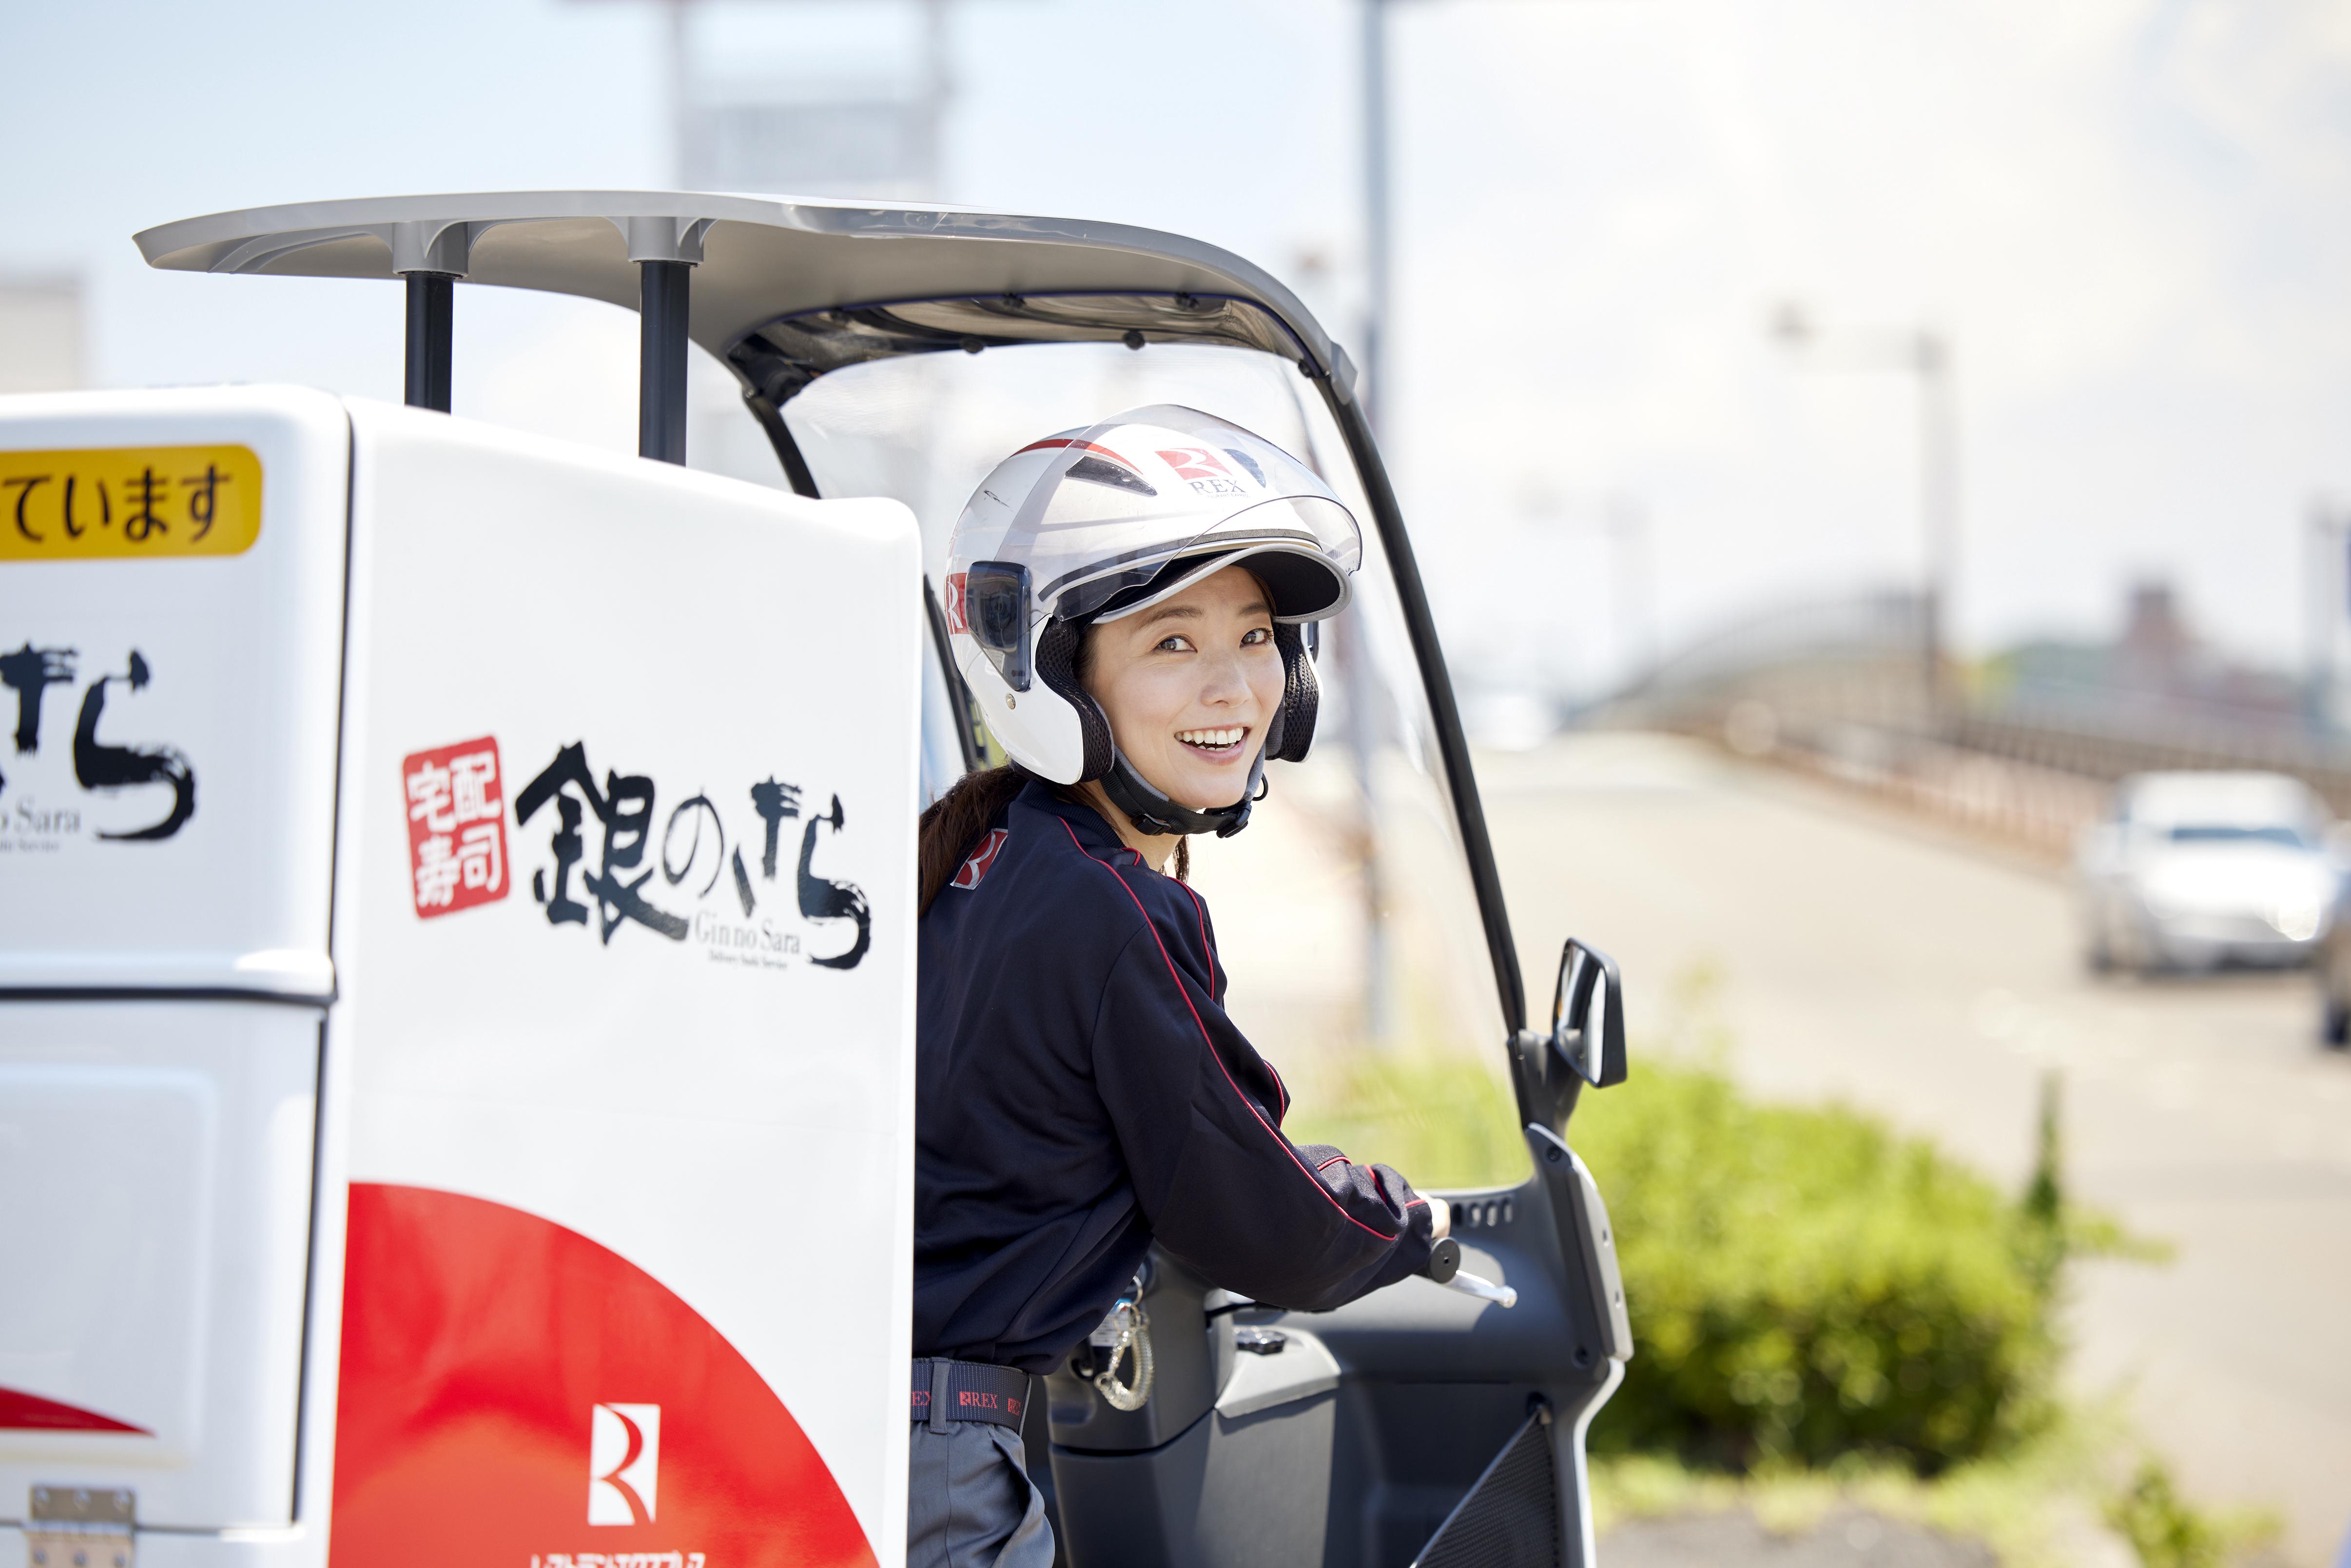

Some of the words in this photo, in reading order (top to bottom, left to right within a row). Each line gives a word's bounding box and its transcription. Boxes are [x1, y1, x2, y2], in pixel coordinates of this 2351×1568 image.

[1187, 480, 1246, 495] REX
[15, 794, 80, 832] Sara
[407, 750, 503, 832] 宅配
[415, 822, 503, 908] 寿司
[515, 741, 871, 970] 銀のさら
[695, 910, 730, 946] Gin
[734, 926, 758, 949] no
[760, 917, 801, 954] Sara
[971, 1392, 998, 1409] REX
